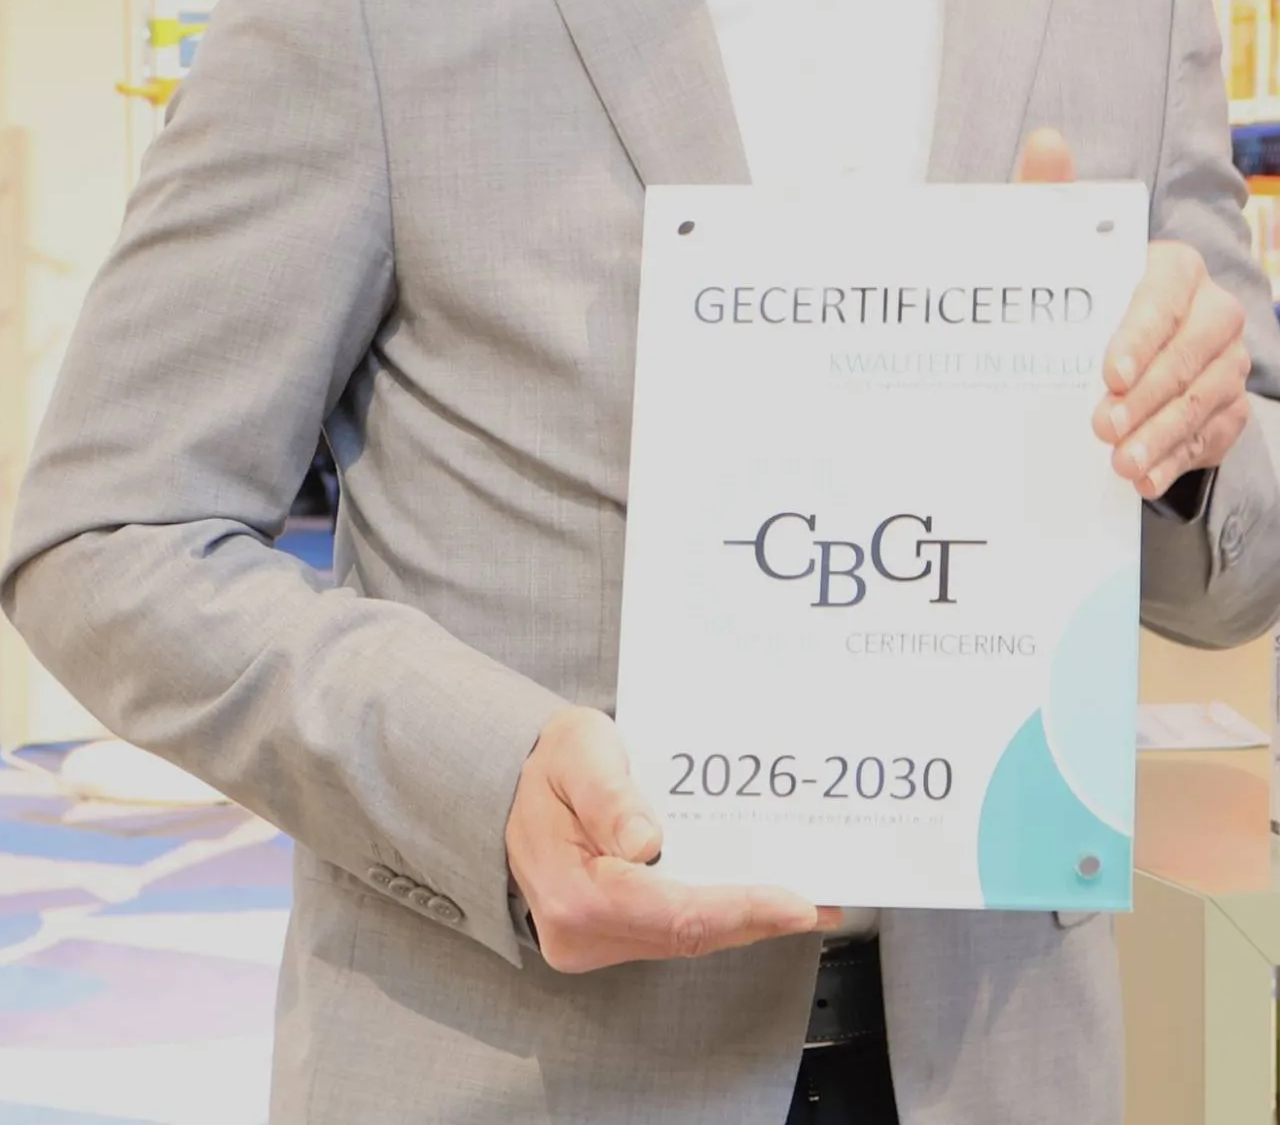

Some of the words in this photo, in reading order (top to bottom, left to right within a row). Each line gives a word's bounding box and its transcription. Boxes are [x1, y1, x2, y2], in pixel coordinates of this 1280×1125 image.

[694, 286, 1094, 325] GECERTIFICEERD
[723, 512, 988, 608] CBCT
[845, 633, 1036, 656] CERTIFICERING
[669, 752, 953, 801] 2026-2030
